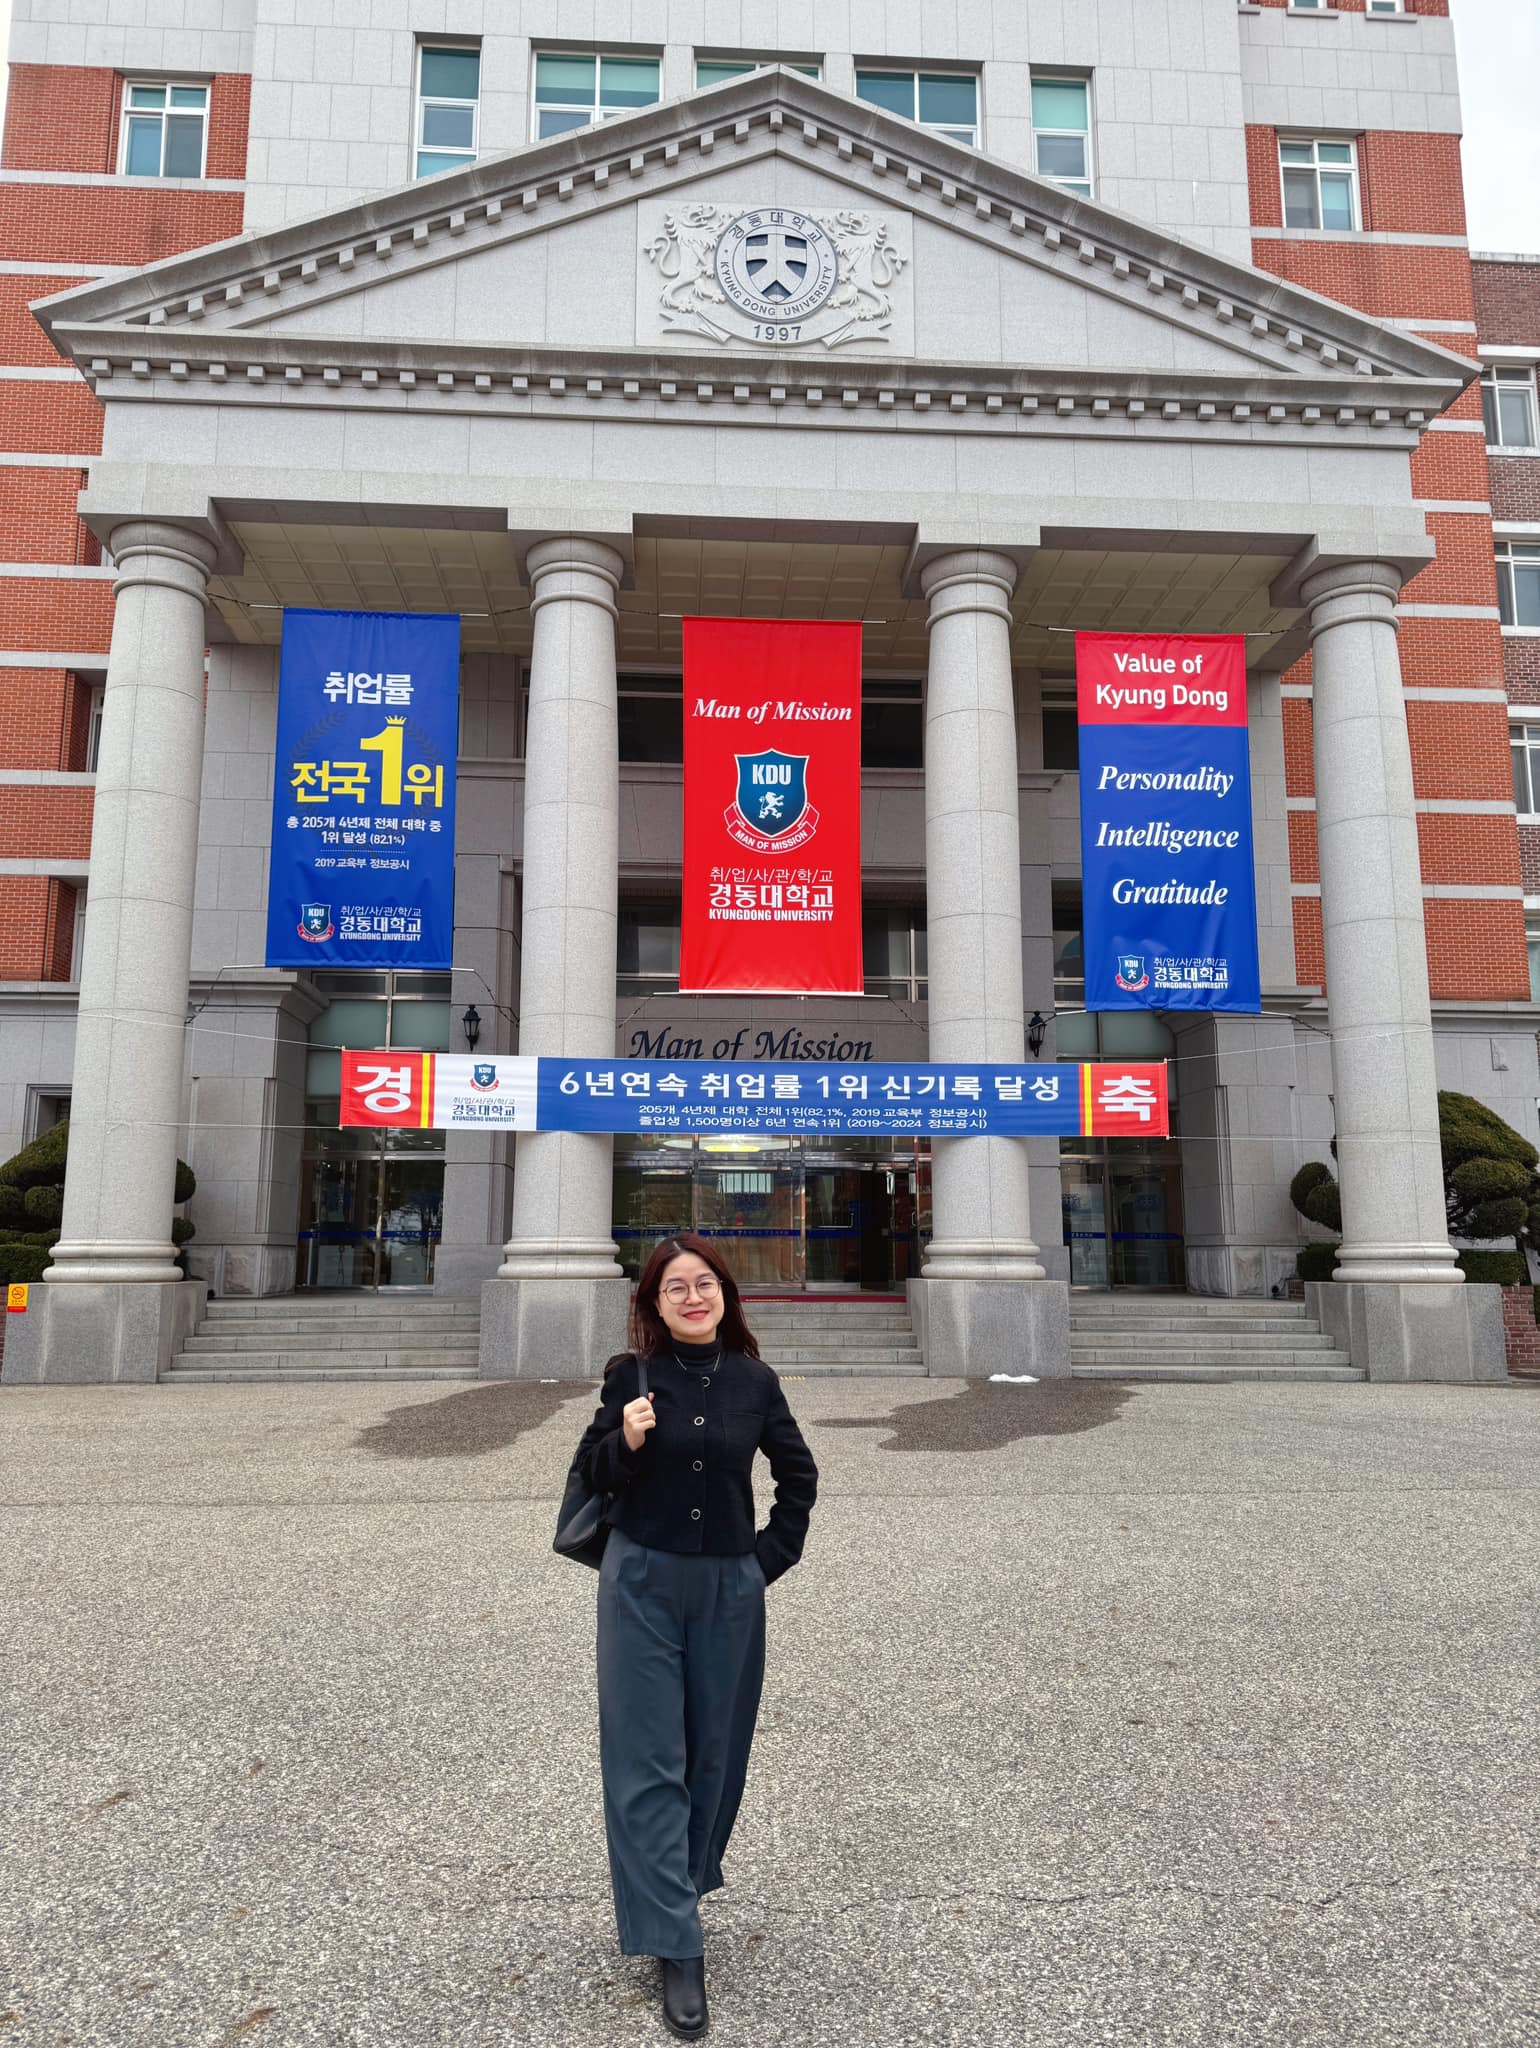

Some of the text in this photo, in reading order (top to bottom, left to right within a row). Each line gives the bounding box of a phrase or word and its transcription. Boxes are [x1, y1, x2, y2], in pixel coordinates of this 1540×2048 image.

[728, 211, 822, 242] 경동대학교
[720, 261, 832, 315] KYUNG DONG UNIVERSITY
[753, 325, 802, 341] 1997
[1114, 653, 1203, 674] Value of
[323, 671, 414, 705] 취업률
[1096, 684, 1228, 711] Kyung Dong
[693, 698, 852, 724] Man of Mission
[752, 764, 791, 785] KDU
[1097, 765, 1233, 798] Personality
[302, 817, 335, 829] 205개
[339, 817, 370, 829] 4년제
[374, 817, 398, 830] 전체
[402, 819, 425, 831] 대학
[321, 831, 405, 846] 1위 달성 (82.1%)
[735, 830, 808, 851] MAN OF MISSION
[1095, 822, 1239, 854] Intelligence
[370, 859, 409, 870] 정보공시
[709, 883, 834, 908] 경동대학교
[1112, 878, 1228, 905] Gratitude
[308, 908, 324, 917] KDU
[709, 908, 834, 921] KYUNGDONG UNIVERSITY
[340, 916, 421, 933] 경동대학교
[340, 932, 381, 941] KYUNGDONG
[382, 933, 421, 942] UNIVERSITY
[1154, 967, 1228, 982] 경동대학교
[629, 1026, 875, 1061] Man of Mission
[354, 1066, 412, 1113] 경
[700, 1073, 802, 1099] 취업률
[816, 1075, 868, 1100] 1위
[880, 1075, 982, 1100] 신기록
[994, 1075, 1060, 1101] 달성
[1098, 1075, 1156, 1121] 축
[452, 1105, 516, 1116] 경동대학교
[639, 1105, 675, 1115] 205개
[681, 1105, 716, 1115] 4년제
[722, 1105, 749, 1116] 대학
[852, 1108, 880, 1117] 2019
[766, 1117, 786, 1128] 6년
